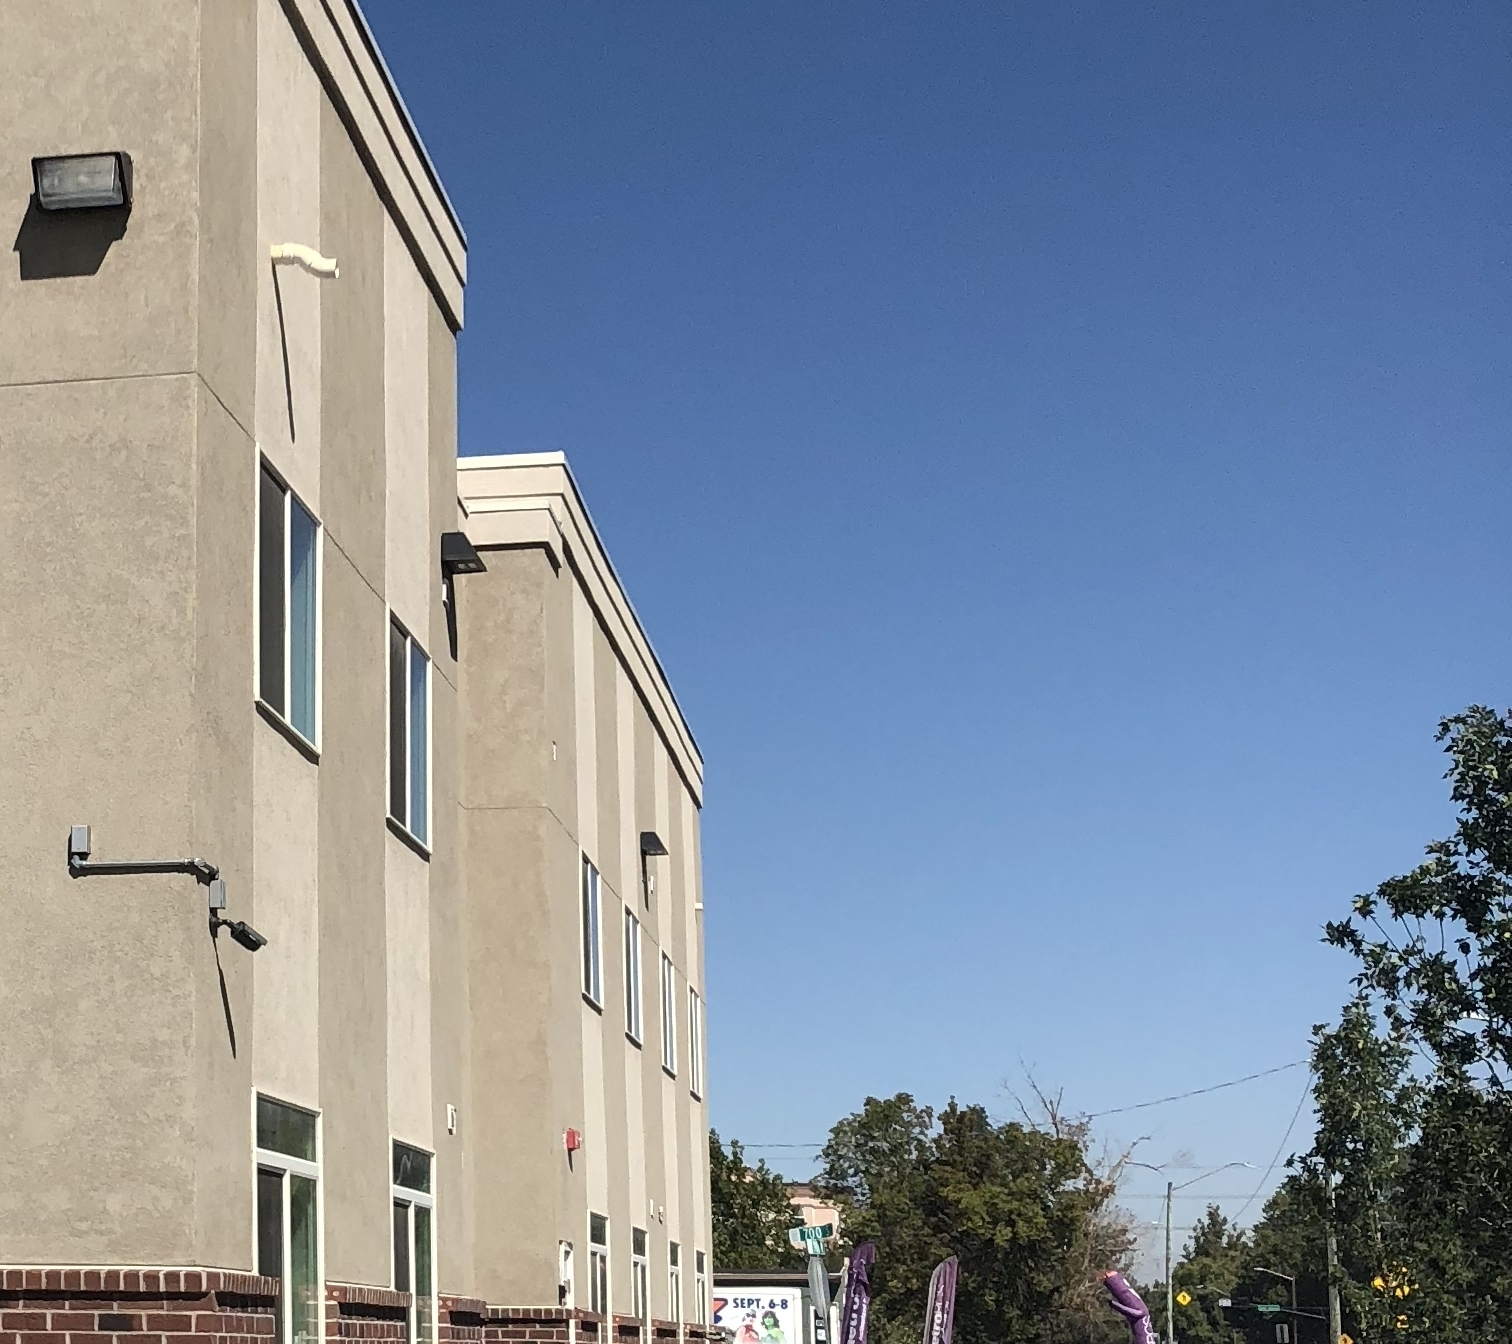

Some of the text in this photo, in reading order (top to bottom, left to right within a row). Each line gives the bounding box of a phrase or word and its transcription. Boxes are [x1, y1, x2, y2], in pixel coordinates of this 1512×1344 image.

[803, 1226, 822, 1240] 700
[732, 1297, 789, 1309] SEPT. 6-8
